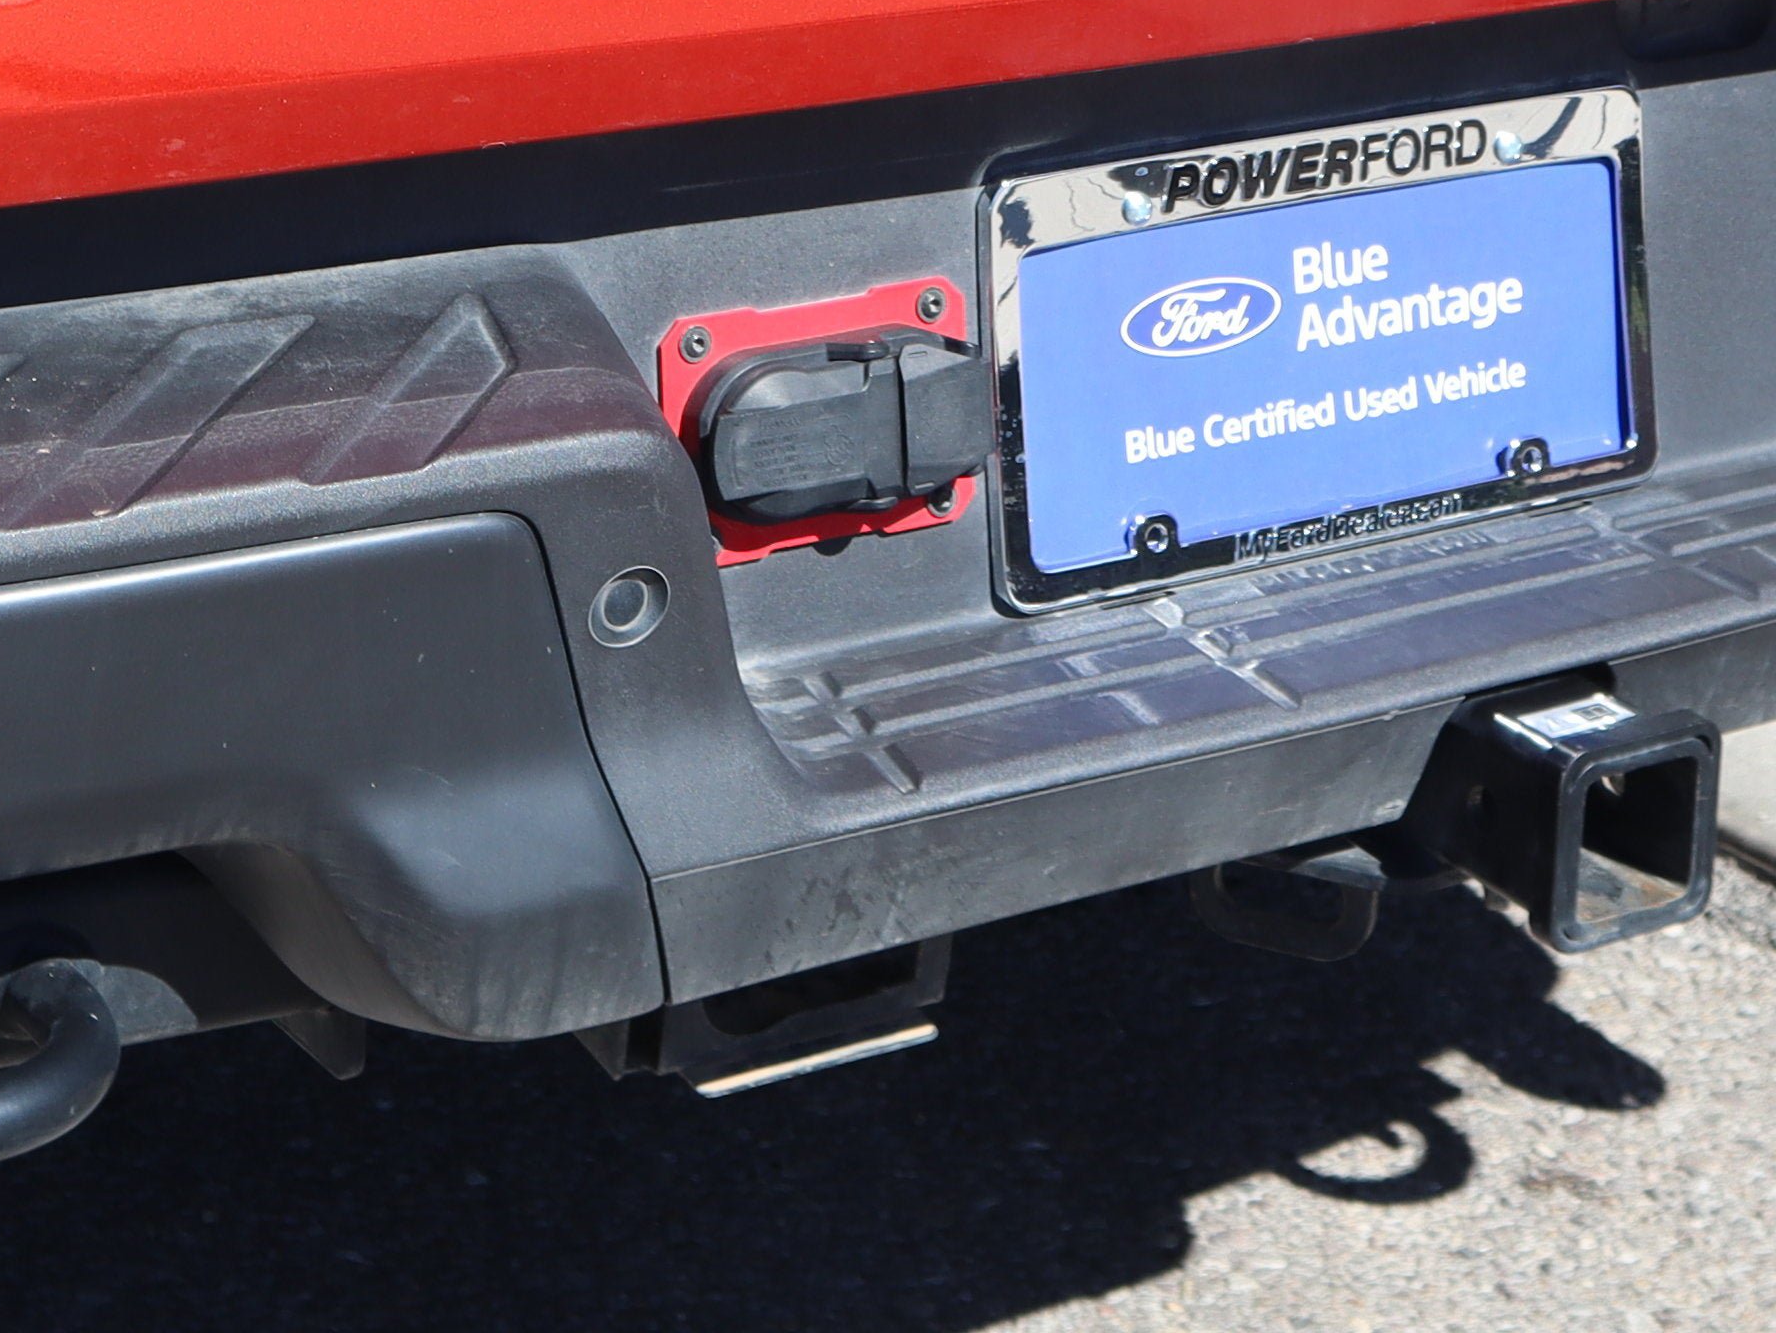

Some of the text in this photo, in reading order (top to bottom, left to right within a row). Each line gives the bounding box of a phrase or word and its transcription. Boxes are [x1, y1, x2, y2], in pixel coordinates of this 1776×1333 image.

[1292, 241, 1389, 295] Blue
[1151, 291, 1251, 347] Ford
[1295, 274, 1523, 352] Advantage
[1124, 358, 1526, 464] Blue Certified Used Vehicle
